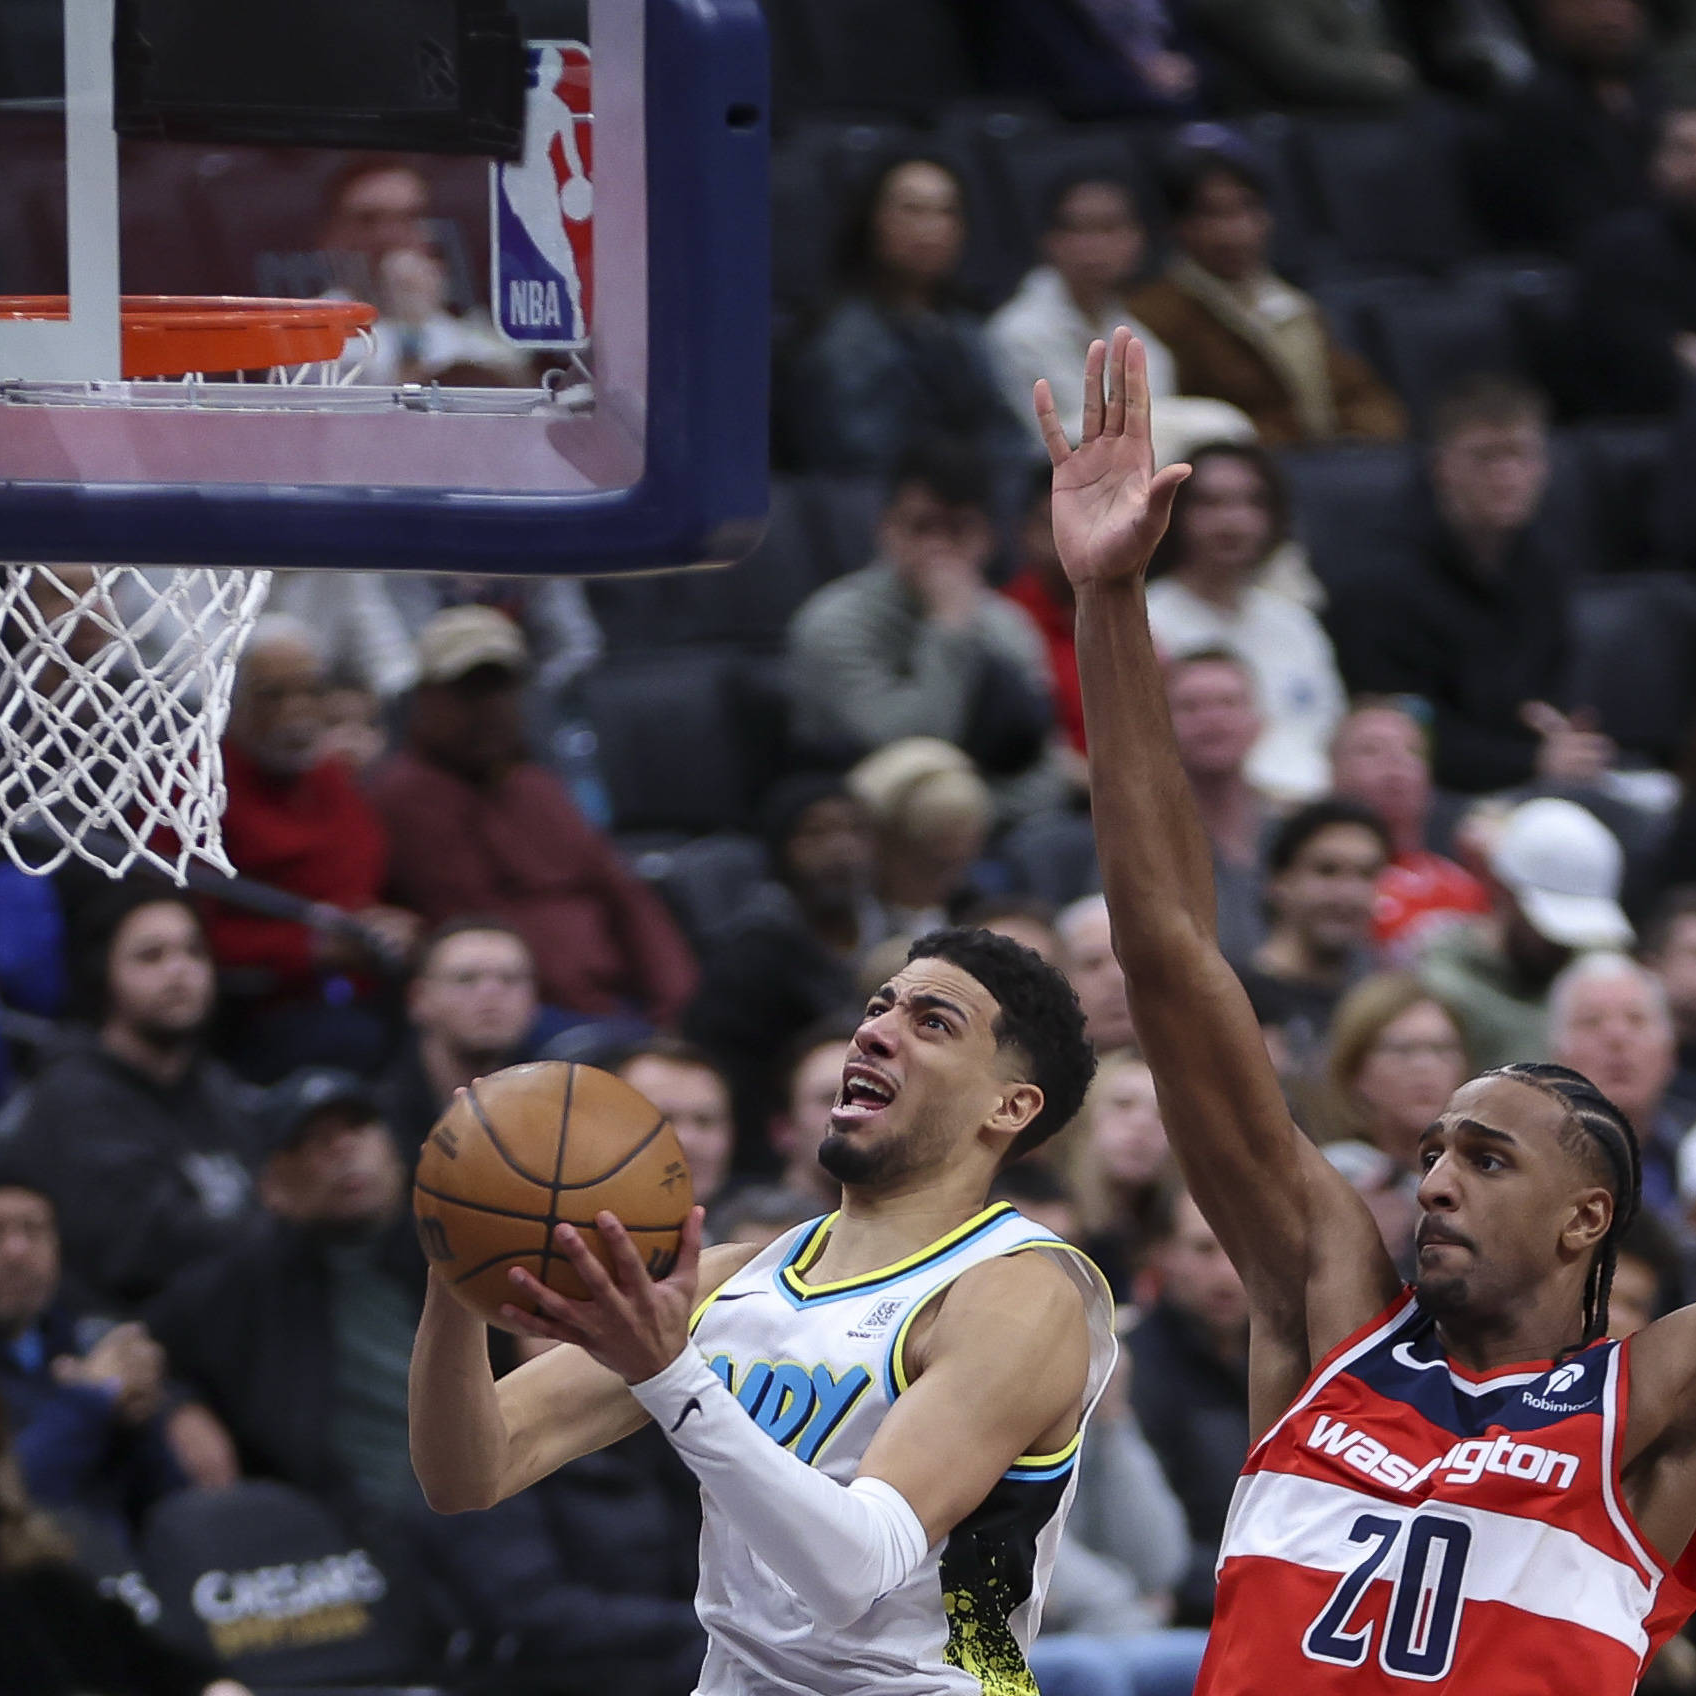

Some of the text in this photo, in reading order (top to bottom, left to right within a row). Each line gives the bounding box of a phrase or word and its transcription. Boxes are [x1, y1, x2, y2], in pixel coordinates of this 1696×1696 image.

[509, 280, 562, 326] NBA
[707, 1350, 877, 1466] NDY
[1302, 1513, 1474, 1683] 20
